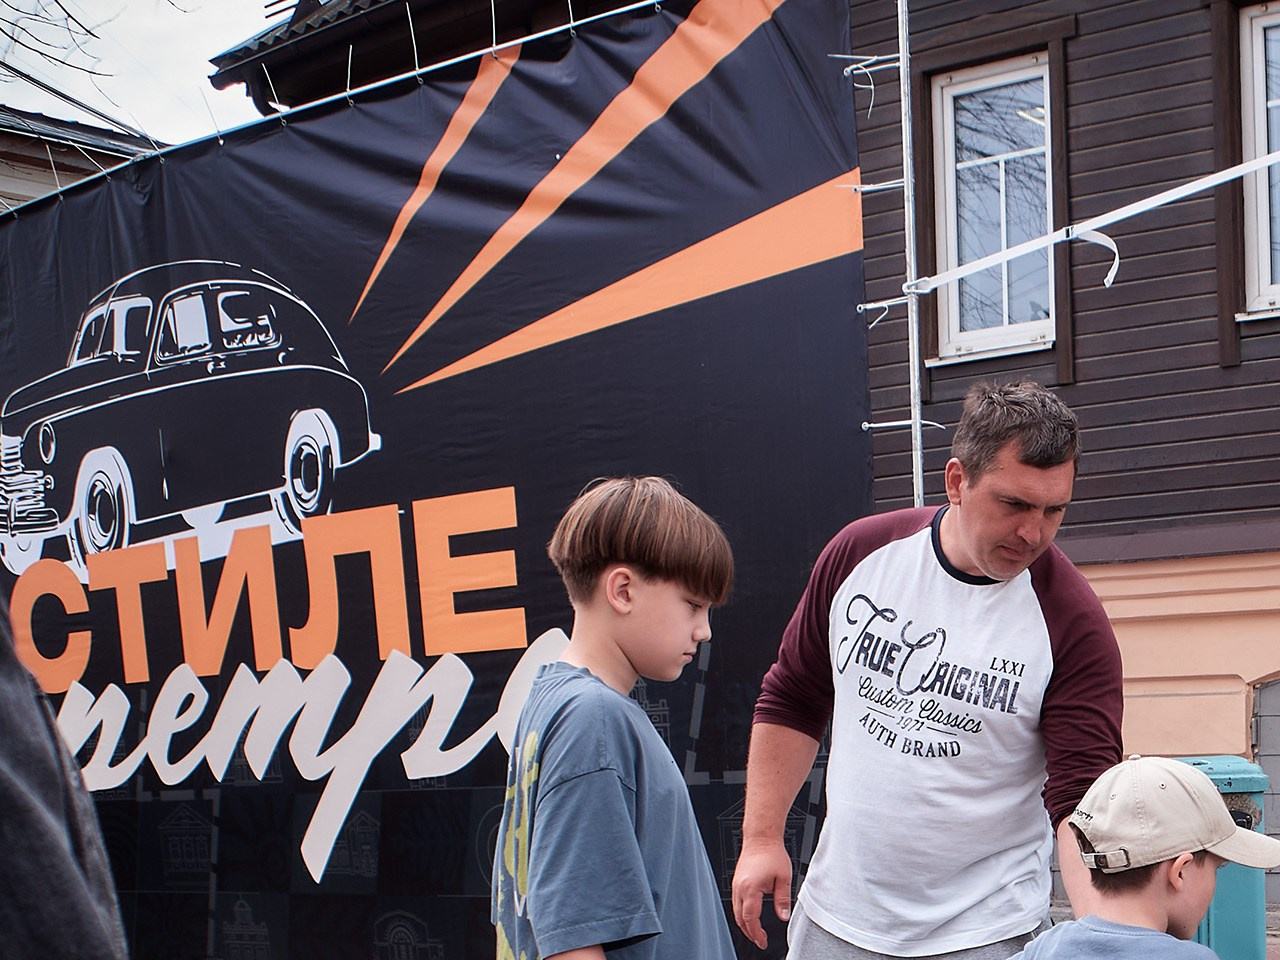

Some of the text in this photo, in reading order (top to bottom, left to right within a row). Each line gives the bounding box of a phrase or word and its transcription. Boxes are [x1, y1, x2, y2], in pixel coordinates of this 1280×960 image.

[11, 486, 528, 694] СТИЛЕ
[989, 656, 1026, 678] LXXI
[858, 675, 982, 734] Custom Classics
[896, 716, 925, 732] 1971
[858, 712, 961, 758] AUTH BRAND
